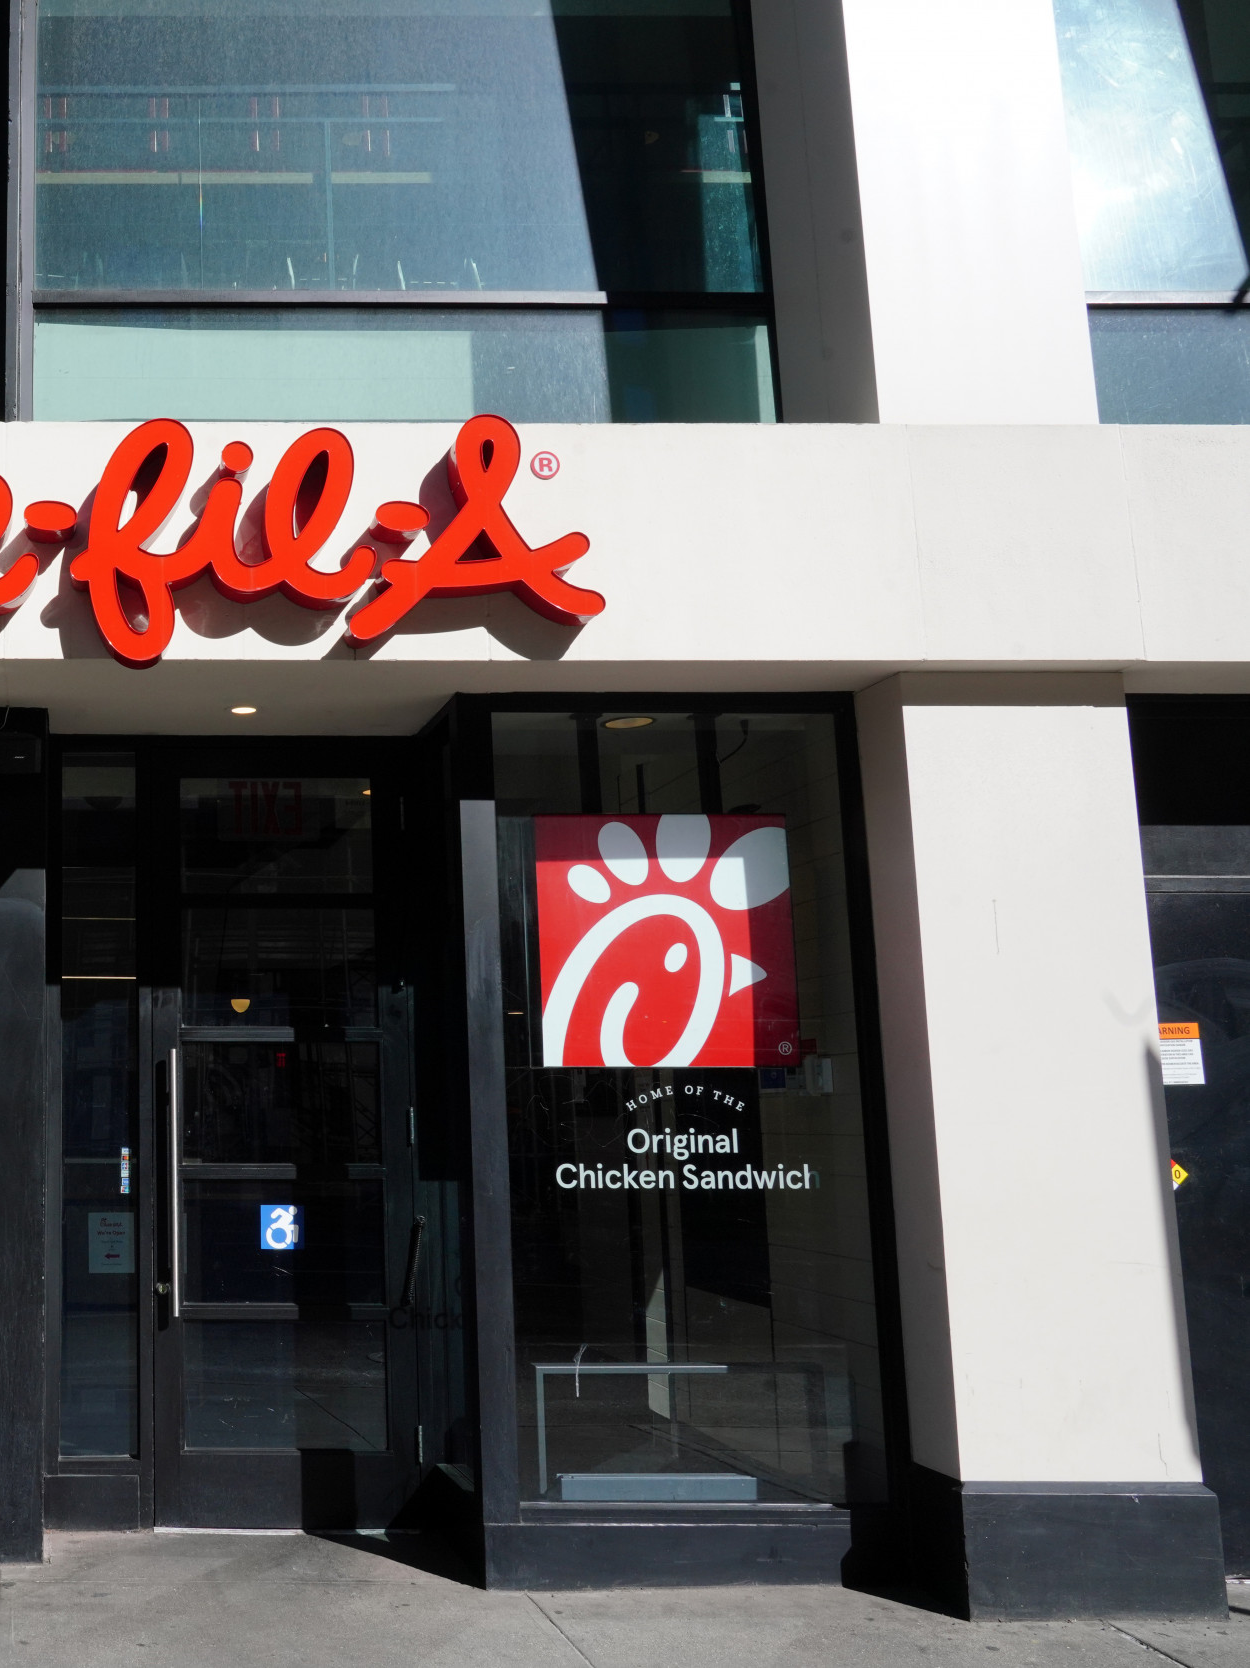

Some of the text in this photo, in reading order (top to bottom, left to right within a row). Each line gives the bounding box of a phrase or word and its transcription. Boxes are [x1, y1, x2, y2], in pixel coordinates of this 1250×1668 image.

[625, 1085, 746, 1112] HOME OF THE
[626, 1127, 739, 1161] Original
[555, 1162, 821, 1190] Chicken Sandwich
[1174, 1169, 1181, 1179] 0
